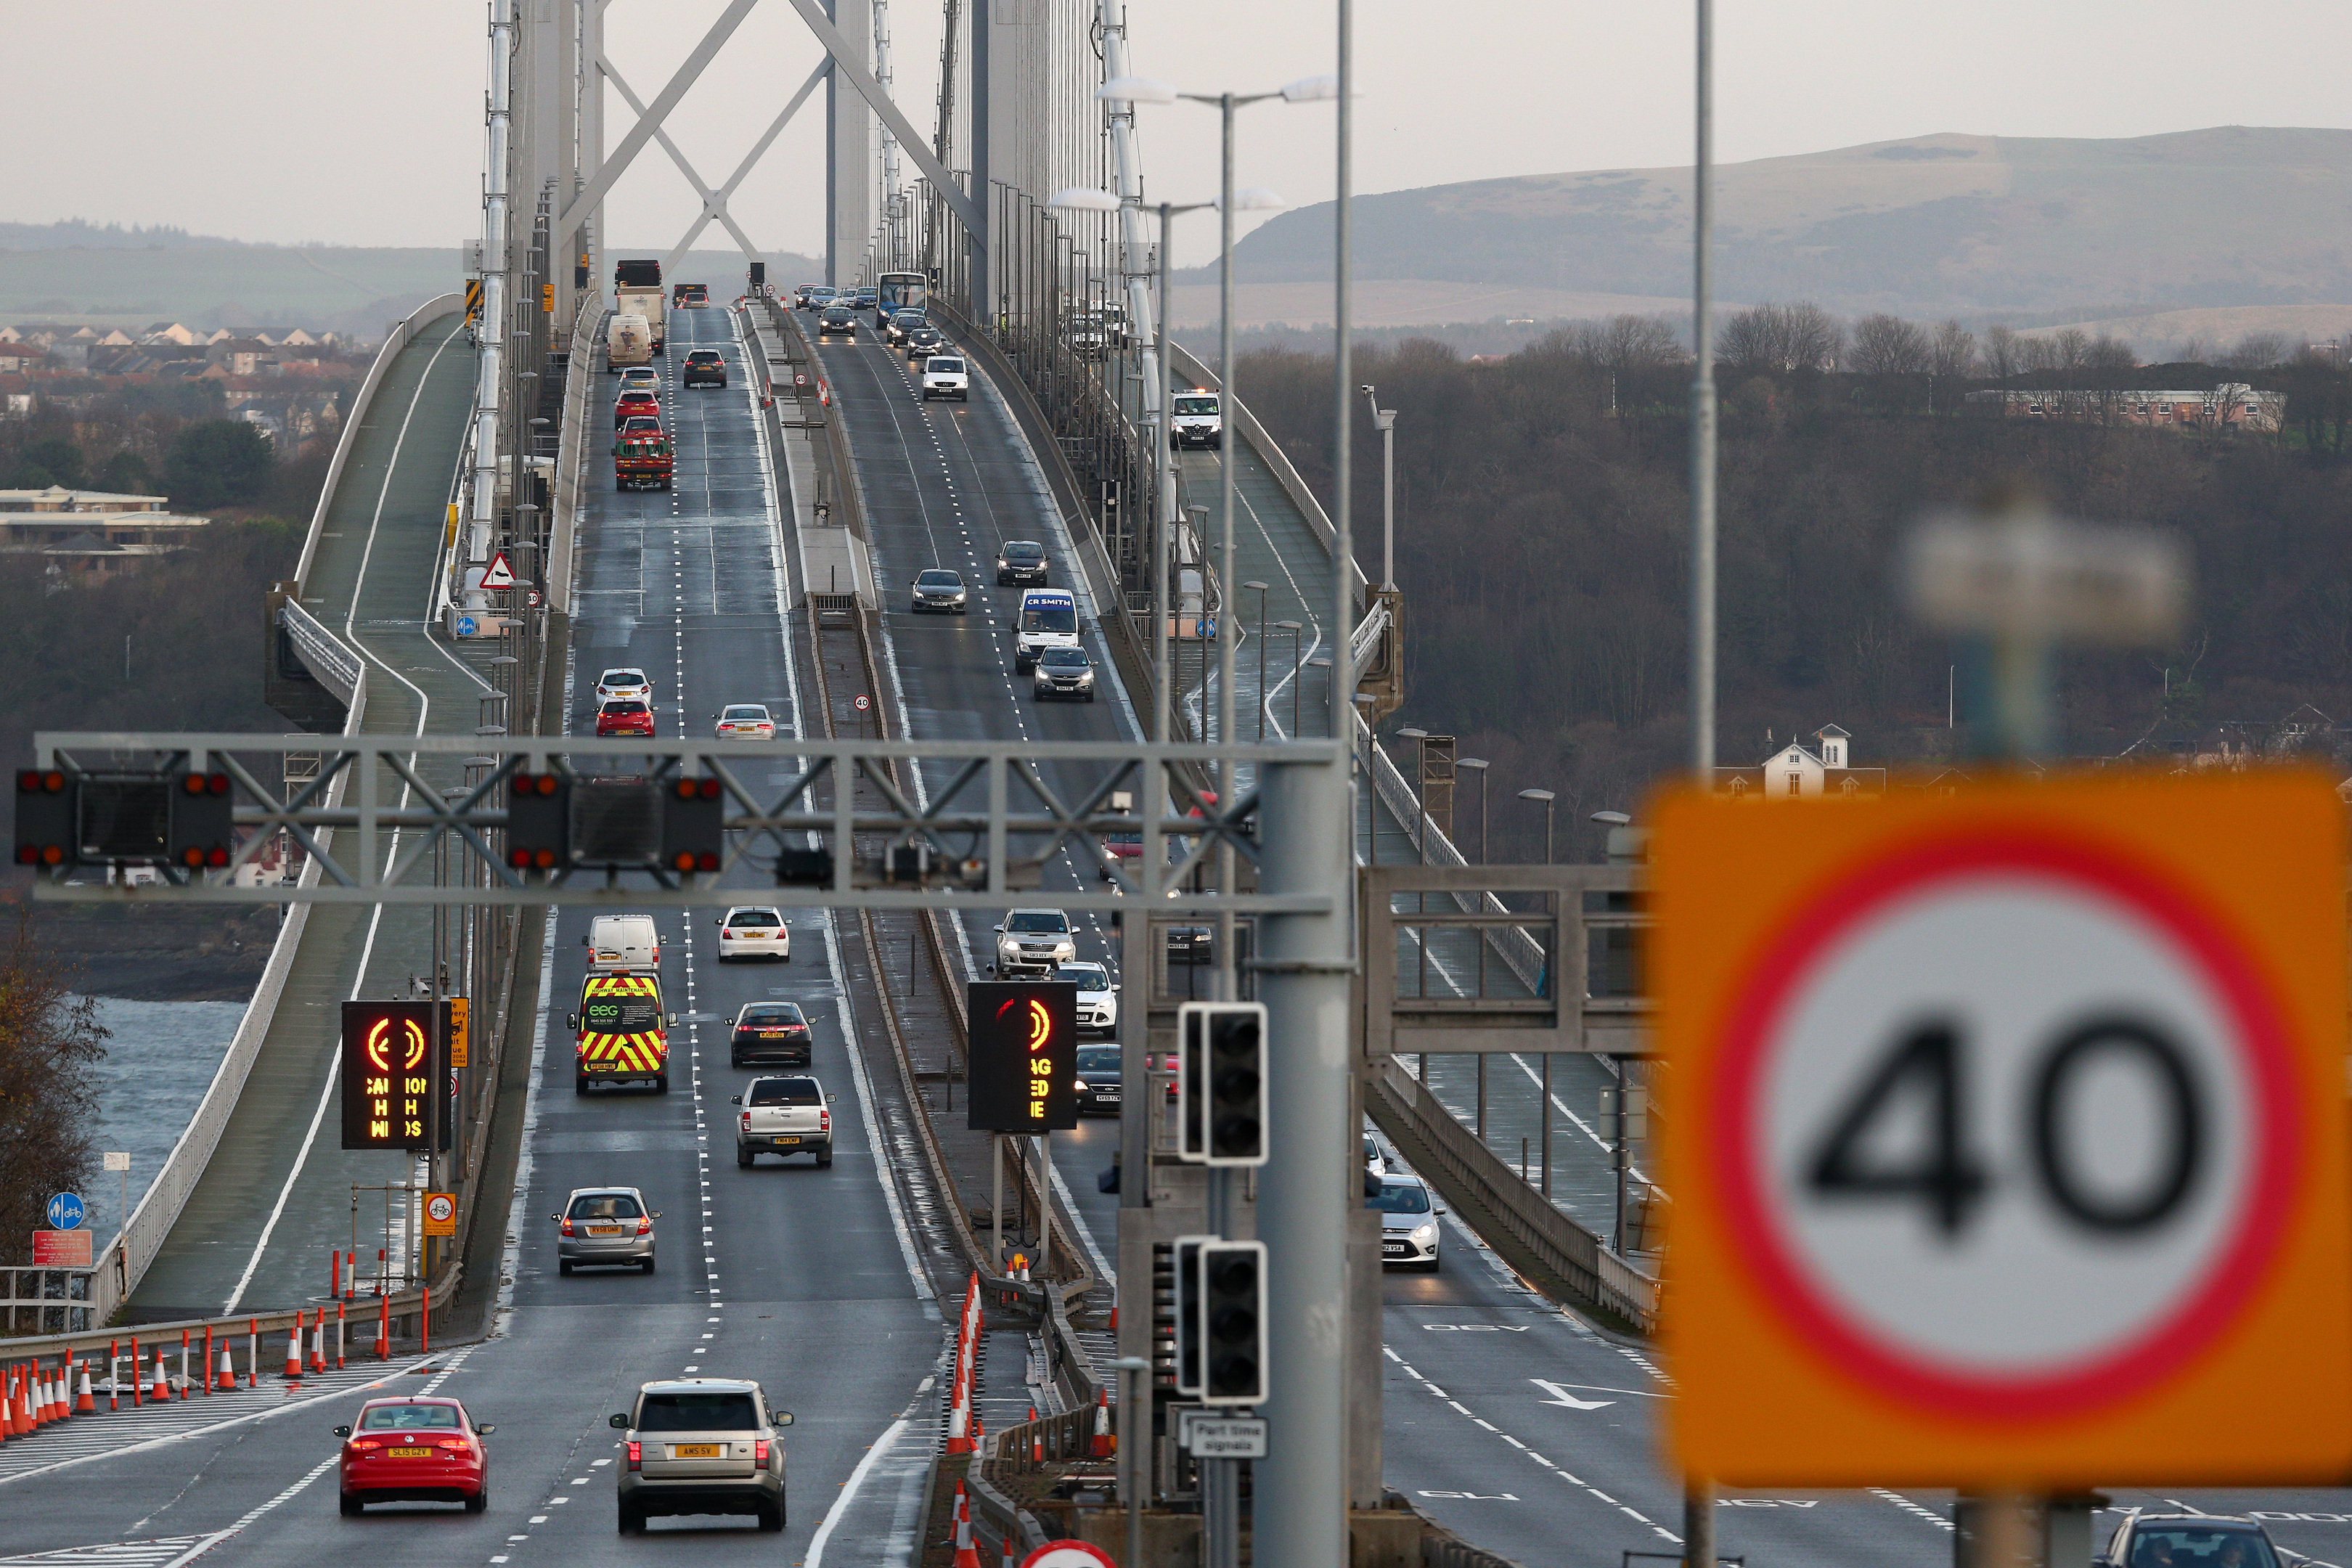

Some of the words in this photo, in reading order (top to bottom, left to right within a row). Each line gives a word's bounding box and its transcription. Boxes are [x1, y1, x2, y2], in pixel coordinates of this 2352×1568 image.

[1806, 1009, 2207, 1251] 40
[1197, 1424, 1226, 1434] Part
[1230, 1425, 1260, 1435] time
[1205, 1441, 1252, 1451] signals
